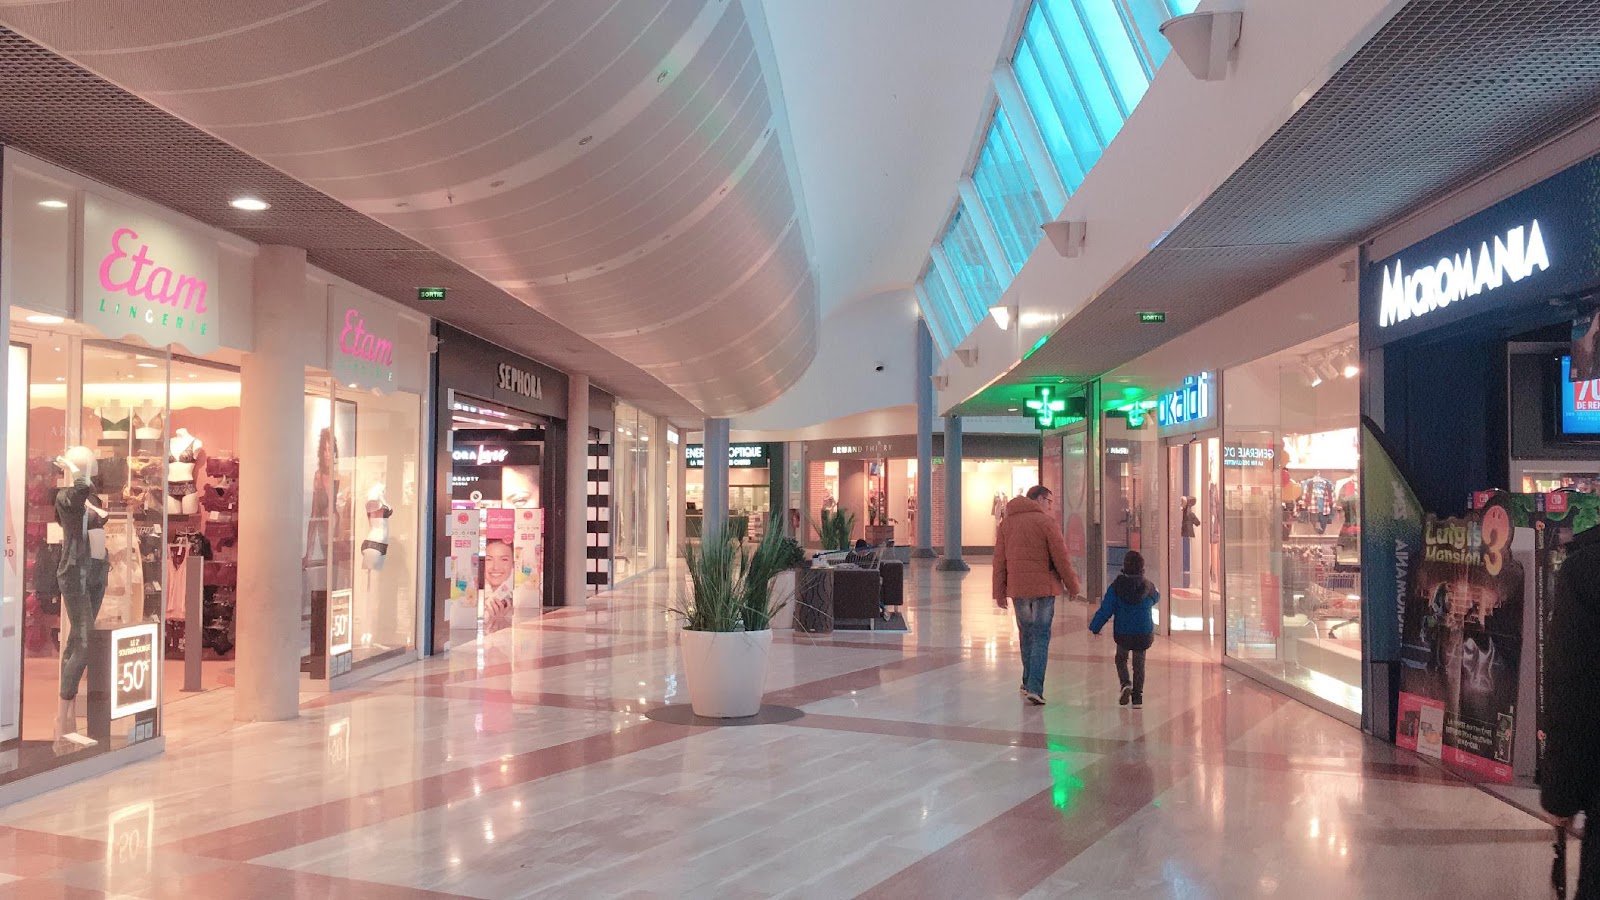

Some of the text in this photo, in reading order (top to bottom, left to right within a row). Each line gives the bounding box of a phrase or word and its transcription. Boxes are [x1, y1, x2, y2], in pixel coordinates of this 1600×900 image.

[98, 227, 208, 314] Etam
[1379, 218, 1550, 328] MICROMANIA
[339, 308, 394, 366] Etam
[498, 362, 543, 400] SEPHORA
[832, 445, 863, 454] ARMAND
